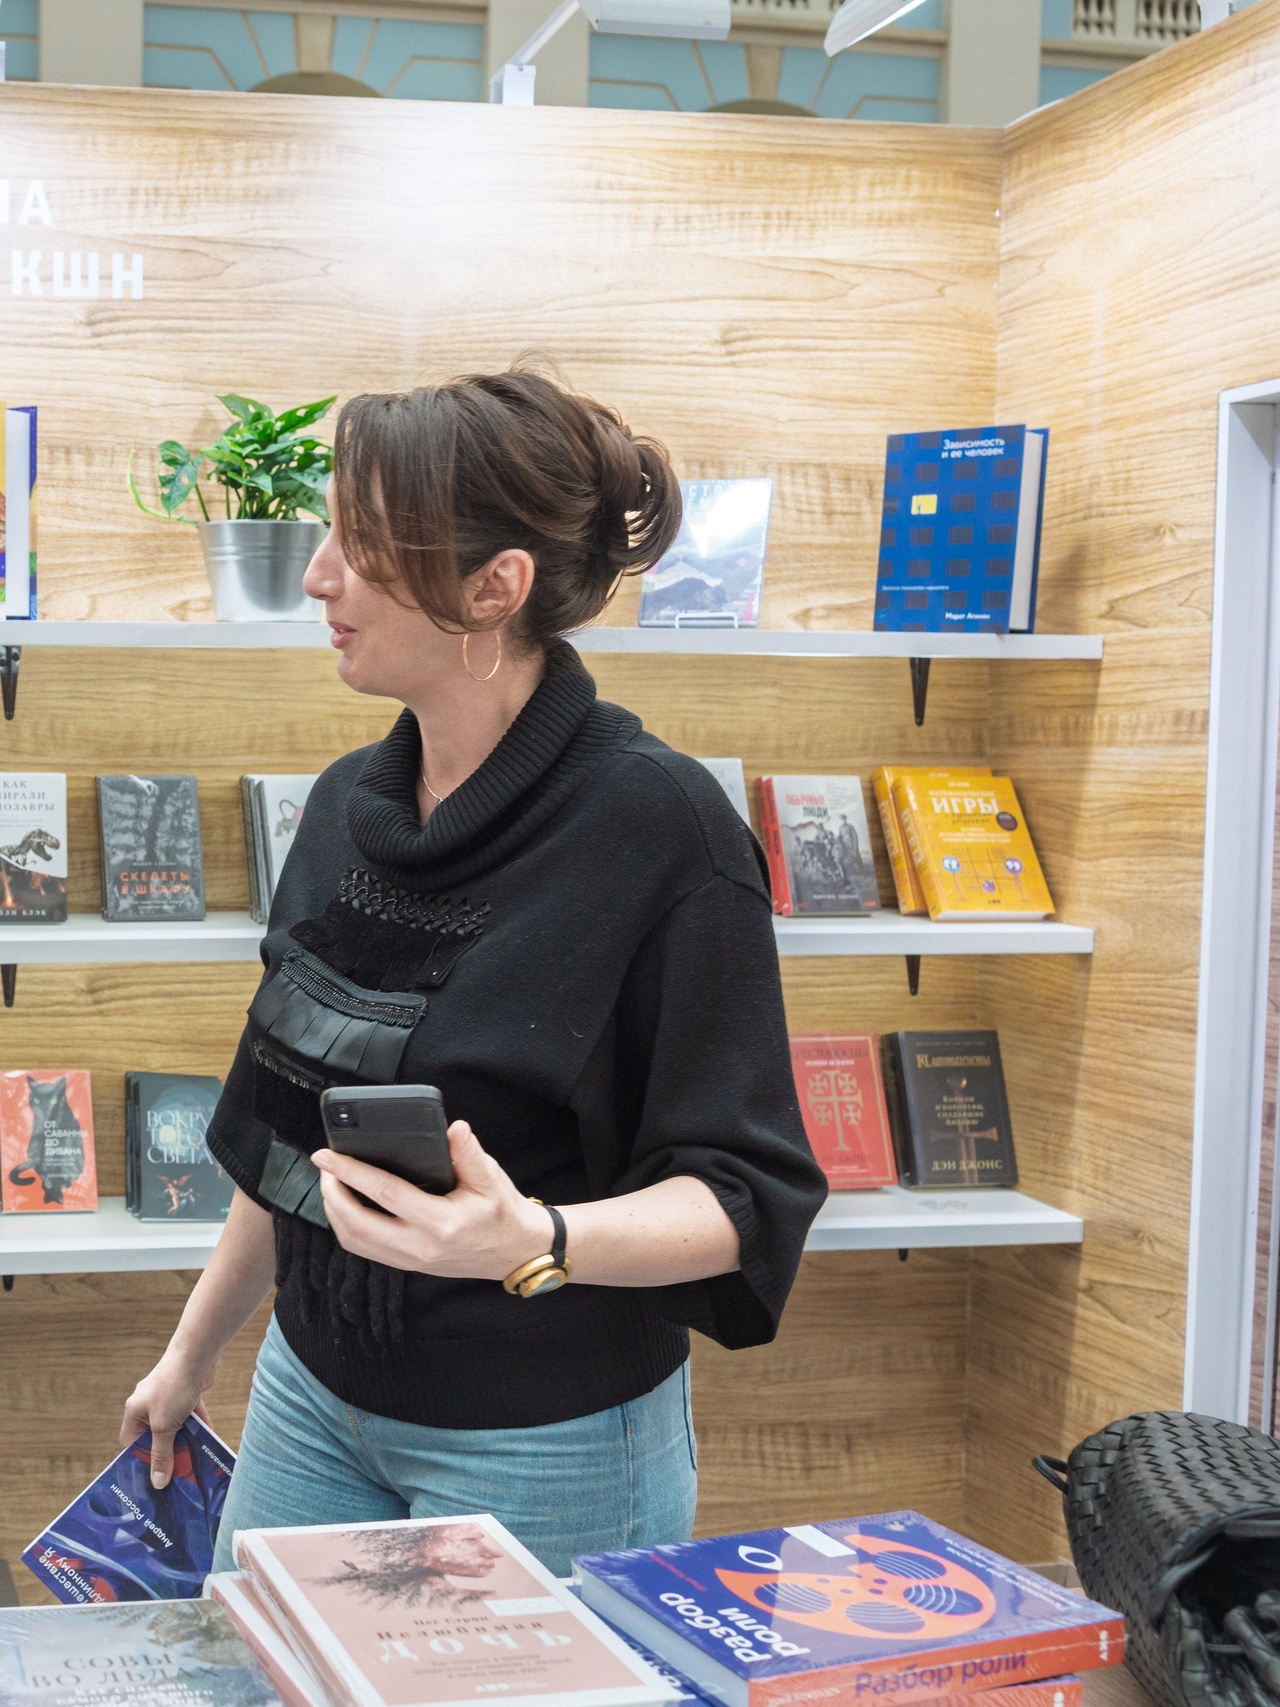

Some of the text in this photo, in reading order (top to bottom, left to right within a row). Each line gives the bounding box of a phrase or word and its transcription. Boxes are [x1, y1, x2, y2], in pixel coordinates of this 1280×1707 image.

[943, 438, 1006, 451] Зависимость
[941, 447, 1005, 459] и ее человек
[2, 780, 28, 789] КАК
[802, 806, 829, 819] ЛЮДИ
[931, 797, 1000, 815] ИГРЫ
[120, 871, 191, 882] СКЕЛЕТЫ
[121, 884, 191, 896] В ШКАФУ
[21, 908, 48, 917] БЛЭК
[43, 1120, 57, 1129] ОТ
[146, 1110, 210, 1130] ВОКРУ
[43, 1129, 89, 1138] САВАННЫ
[44, 1137, 60, 1147] ДО
[45, 1147, 82, 1156] ДИВАНА
[146, 1145, 214, 1166] СВЕТА
[931, 1159, 1004, 1172] ДЭН ДЖОНС
[110, 1483, 173, 1549] Андрей Россохин
[38, 1555, 89, 1605] тешествие
[44, 1546, 107, 1604] длинному Я
[659, 1592, 773, 1664] Разбор
[717, 1607, 811, 1658] роли
[376, 1629, 573, 1664] ДОЧЬ
[62, 1653, 173, 1671] СОВЫ
[31, 1665, 221, 1688] ВО ЛЬДАХ
[855, 1663, 954, 1698] Разбор
[961, 1651, 1027, 1684] роли
